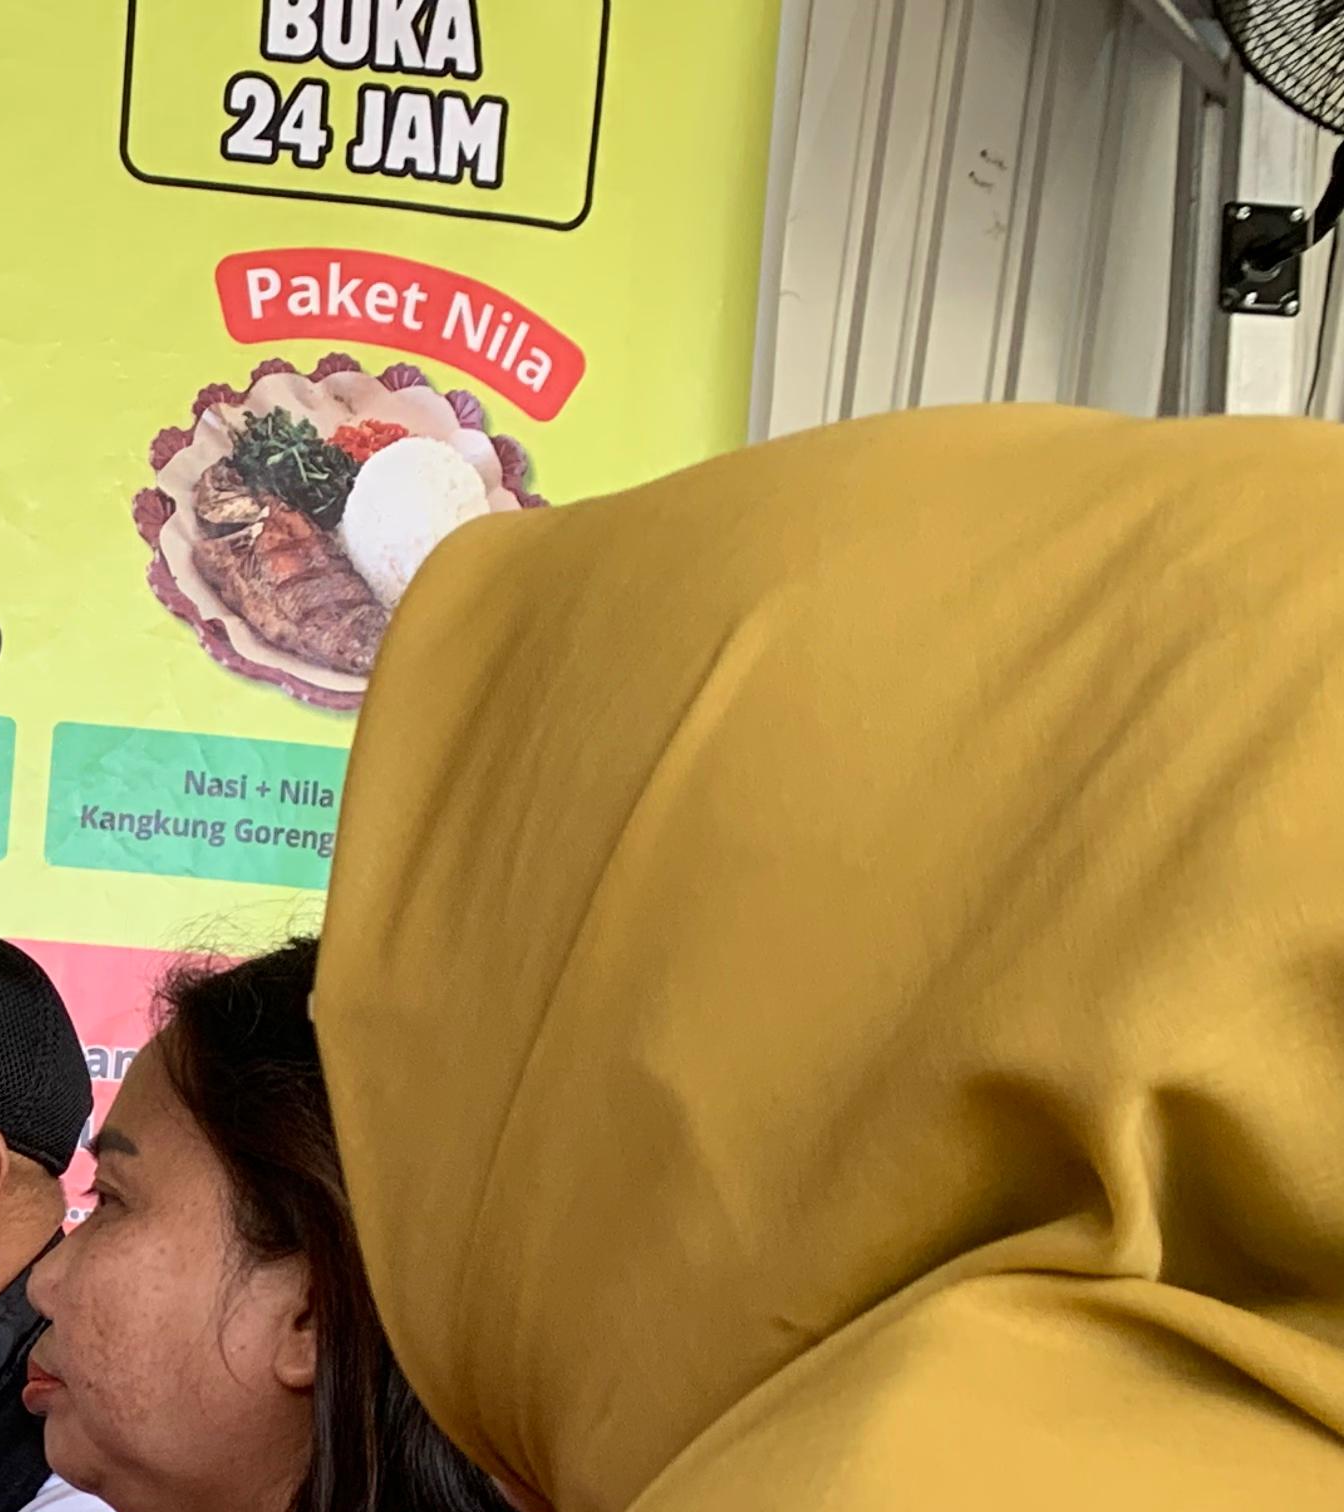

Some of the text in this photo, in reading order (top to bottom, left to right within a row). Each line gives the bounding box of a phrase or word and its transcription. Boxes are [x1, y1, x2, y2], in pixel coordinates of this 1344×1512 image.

[262, 0, 482, 78] BUKA
[222, 72, 508, 188] 24 JAM
[245, 263, 555, 394] Paket Nila
[184, 768, 248, 801] Nasi
[278, 777, 336, 809] Nila
[80, 804, 335, 859] Kangkung Goreng
